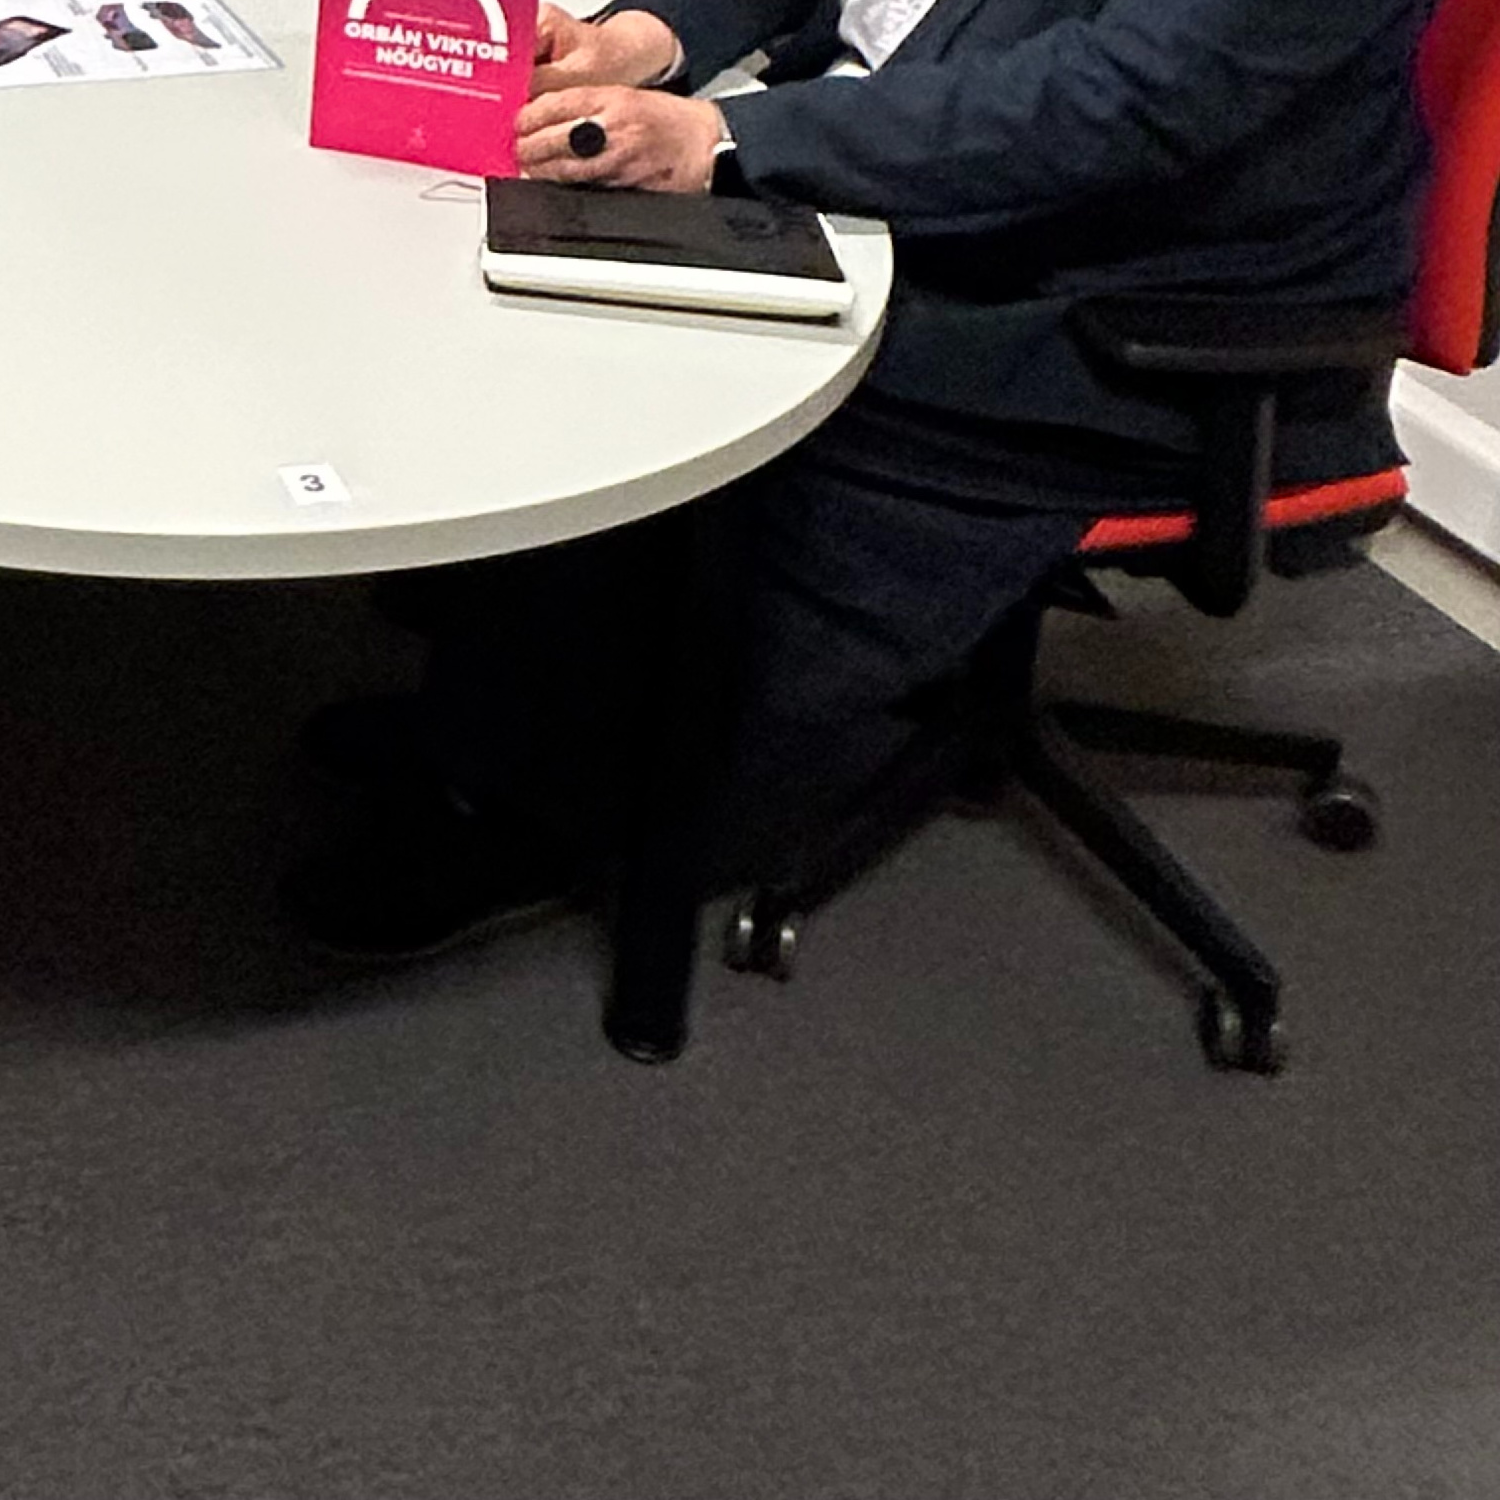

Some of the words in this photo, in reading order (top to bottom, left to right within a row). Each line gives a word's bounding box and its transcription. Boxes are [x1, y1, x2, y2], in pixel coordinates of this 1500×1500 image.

[344, 22, 422, 47] ORBÁN
[426, 33, 508, 62] VIKTOR
[299, 474, 325, 492] 3
